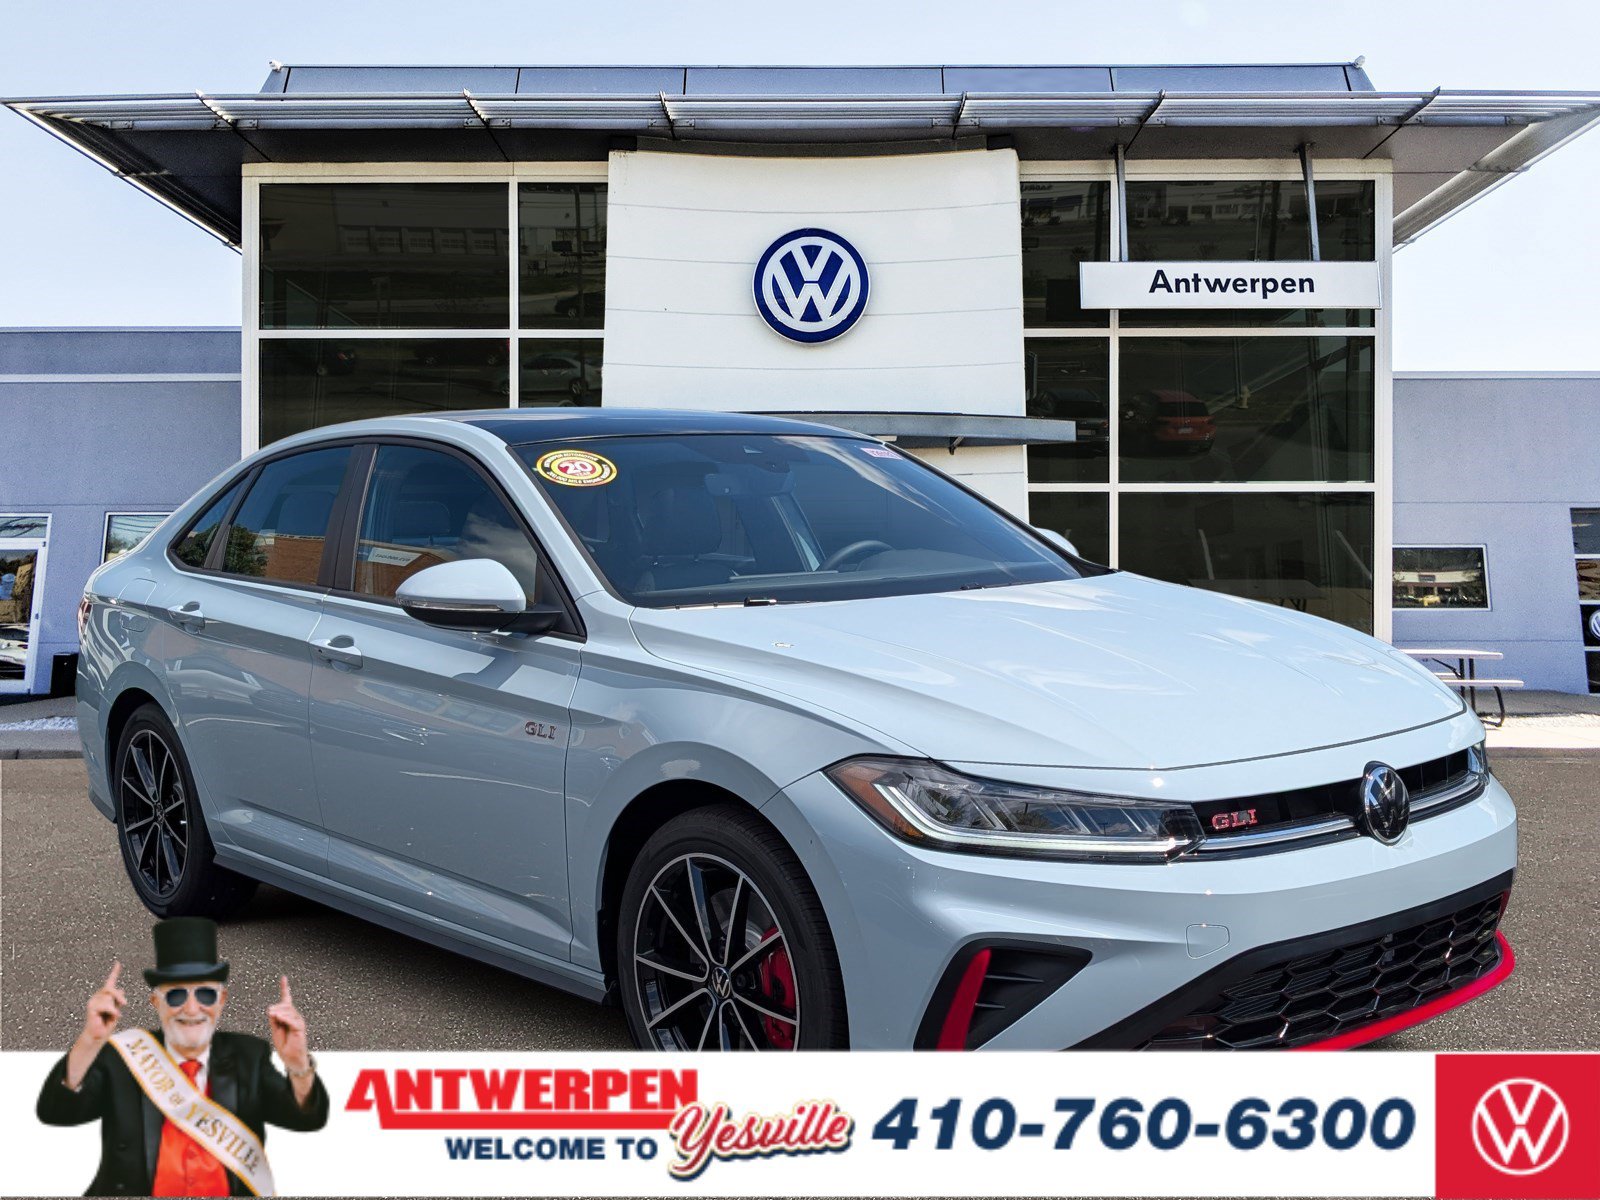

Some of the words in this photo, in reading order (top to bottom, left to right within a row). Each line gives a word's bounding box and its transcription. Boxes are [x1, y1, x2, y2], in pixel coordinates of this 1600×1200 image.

[762, 236, 861, 333] VW
[1149, 269, 1315, 300] Antwerpen
[559, 461, 593, 475] 20
[525, 721, 557, 740] GLI
[1211, 808, 1258, 830] GLI
